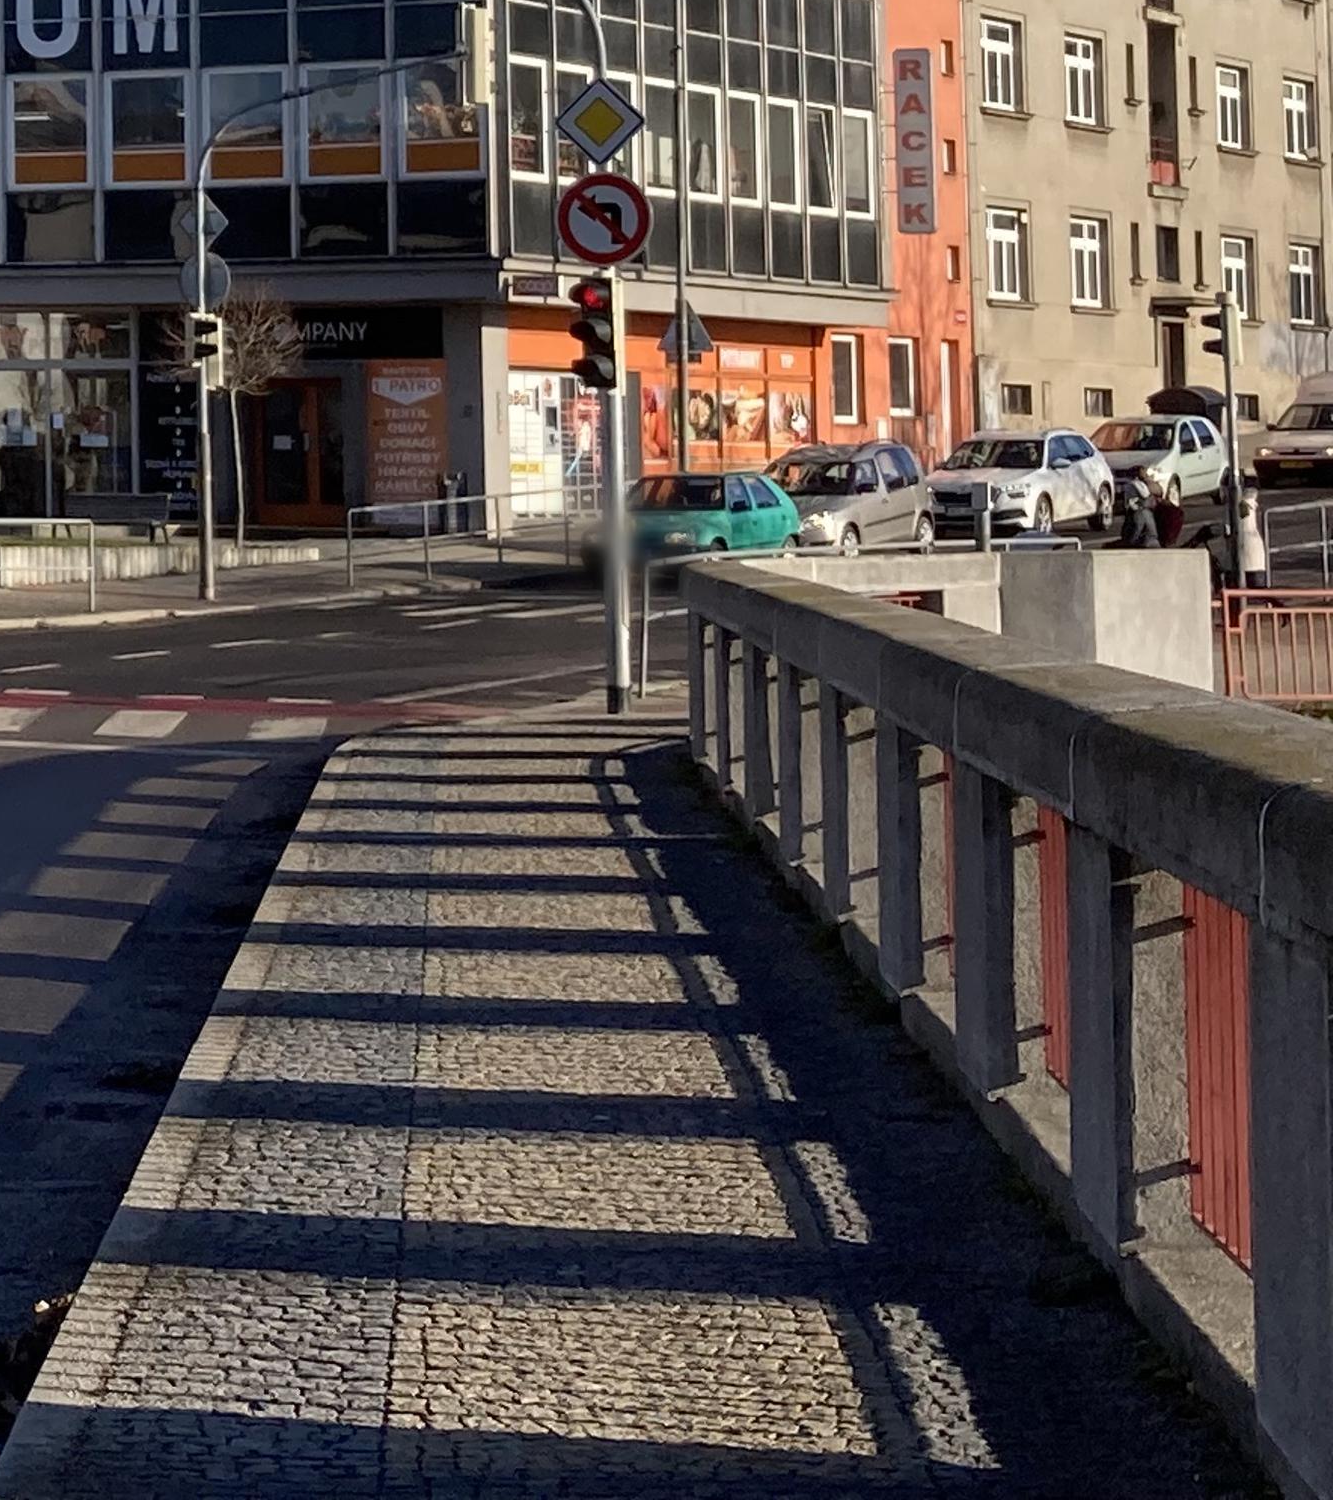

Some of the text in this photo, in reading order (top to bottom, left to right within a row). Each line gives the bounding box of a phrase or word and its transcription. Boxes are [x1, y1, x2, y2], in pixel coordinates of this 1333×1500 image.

[898, 59, 929, 225] RACEK
[389, 379, 439, 392] PATRO
[387, 421, 428, 434] OBUV
